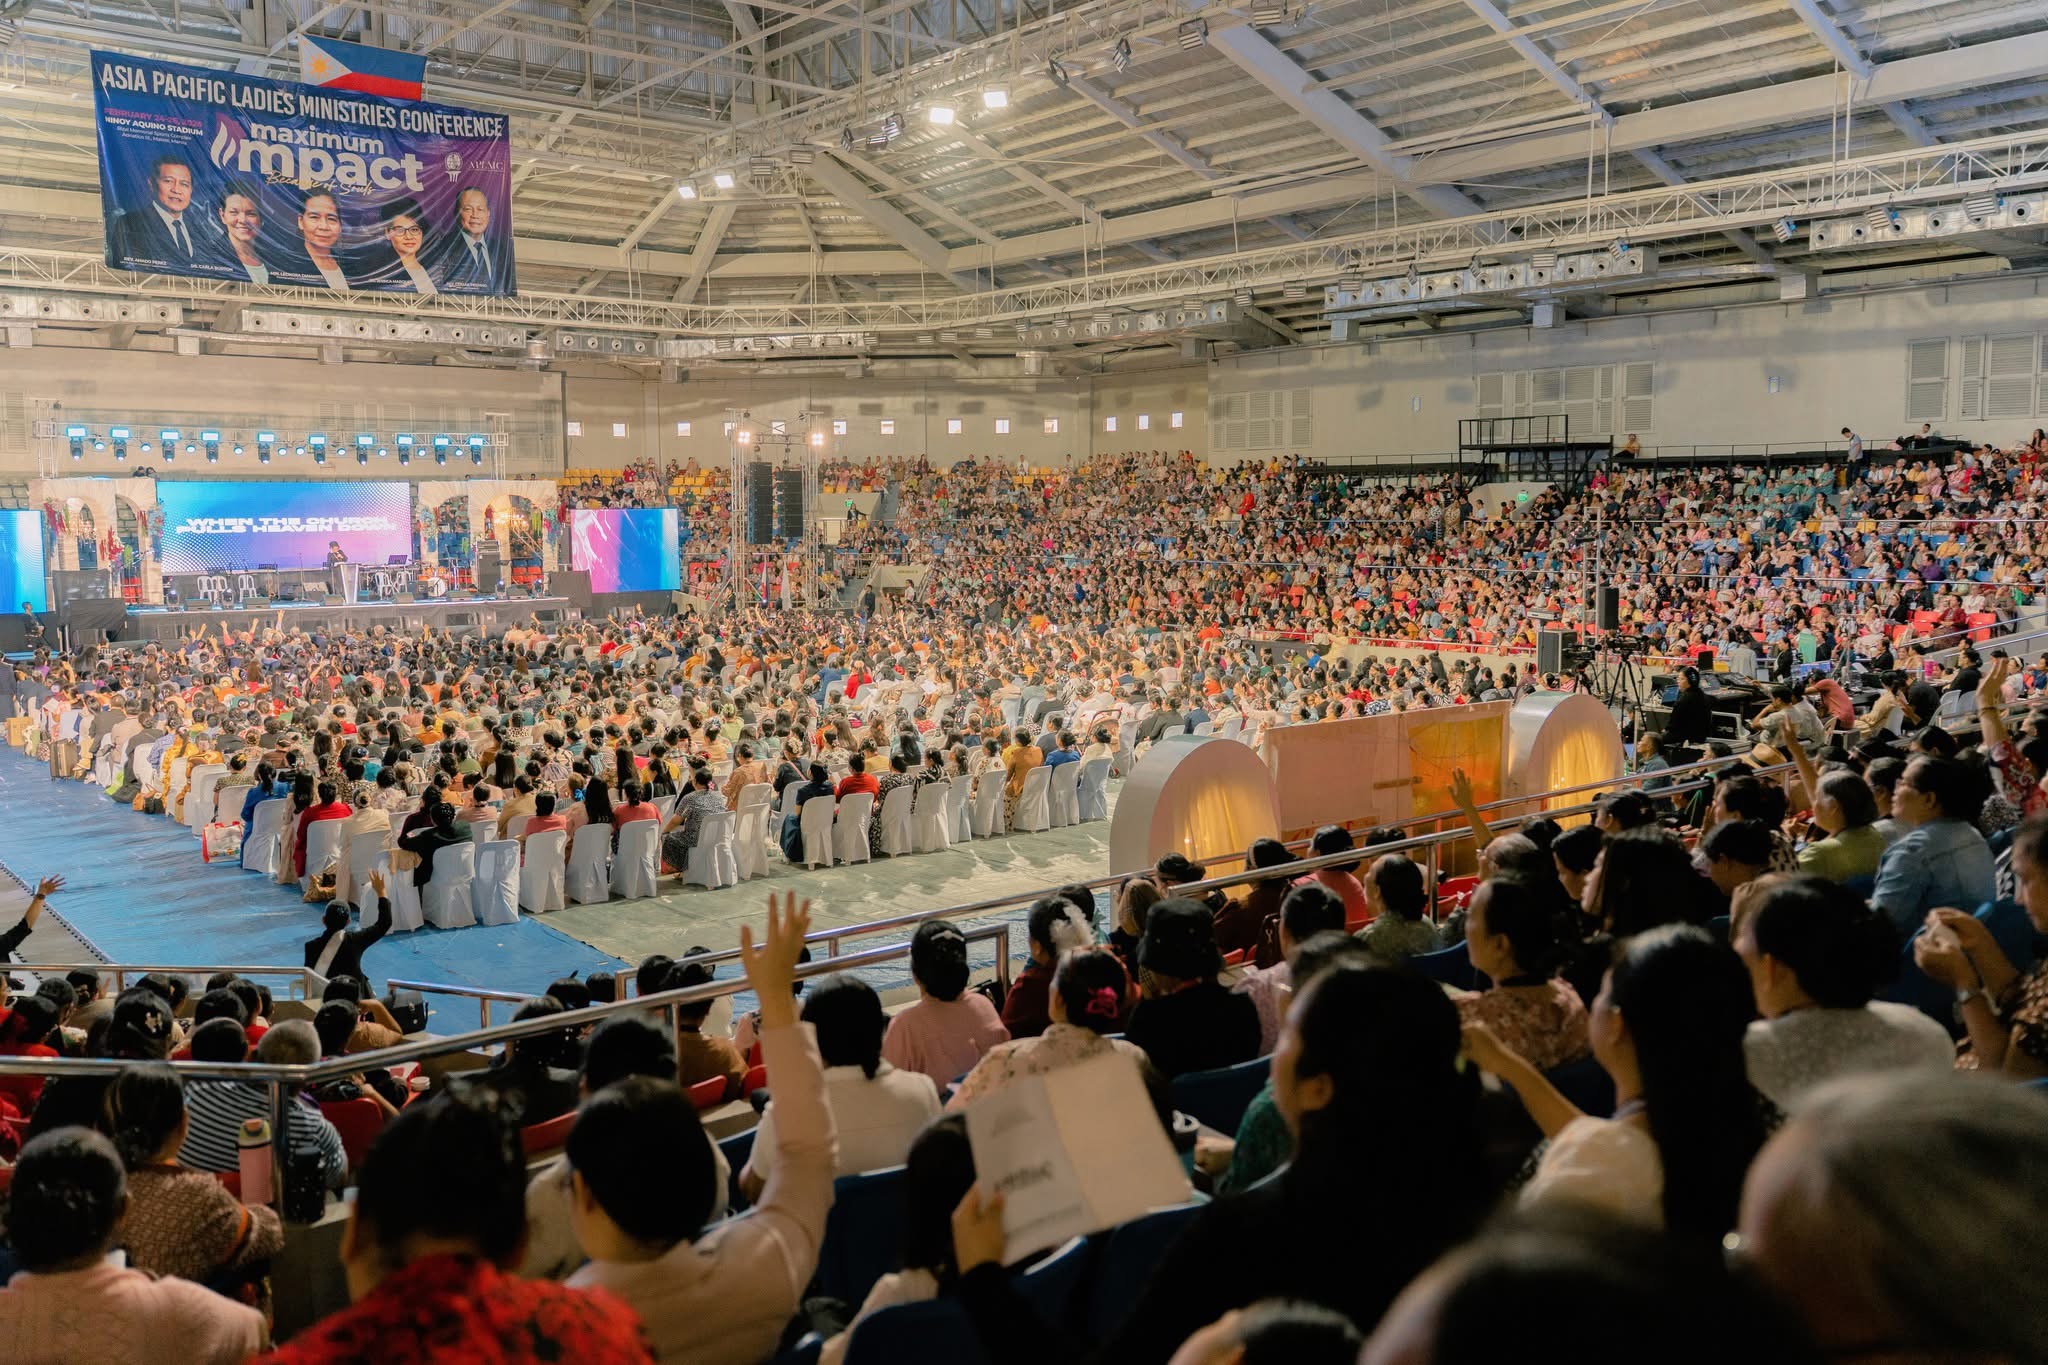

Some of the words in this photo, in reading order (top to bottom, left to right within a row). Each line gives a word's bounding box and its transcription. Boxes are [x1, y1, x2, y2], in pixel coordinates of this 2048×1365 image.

[102, 63, 148, 93] ASIA
[152, 70, 226, 104] PACIFIC
[231, 83, 295, 116] LADIES
[300, 95, 396, 129] MINISTRIES
[401, 109, 503, 138] CONFERENCE
[105, 116, 131, 125] NINOY
[132, 120, 166, 130] AQUINO
[167, 125, 204, 136] STADIUM
[250, 122, 385, 155] maximum
[186, 517, 254, 526] WHEN
[258, 517, 301, 525] THE
[252, 524, 333, 533] HEAVEN
